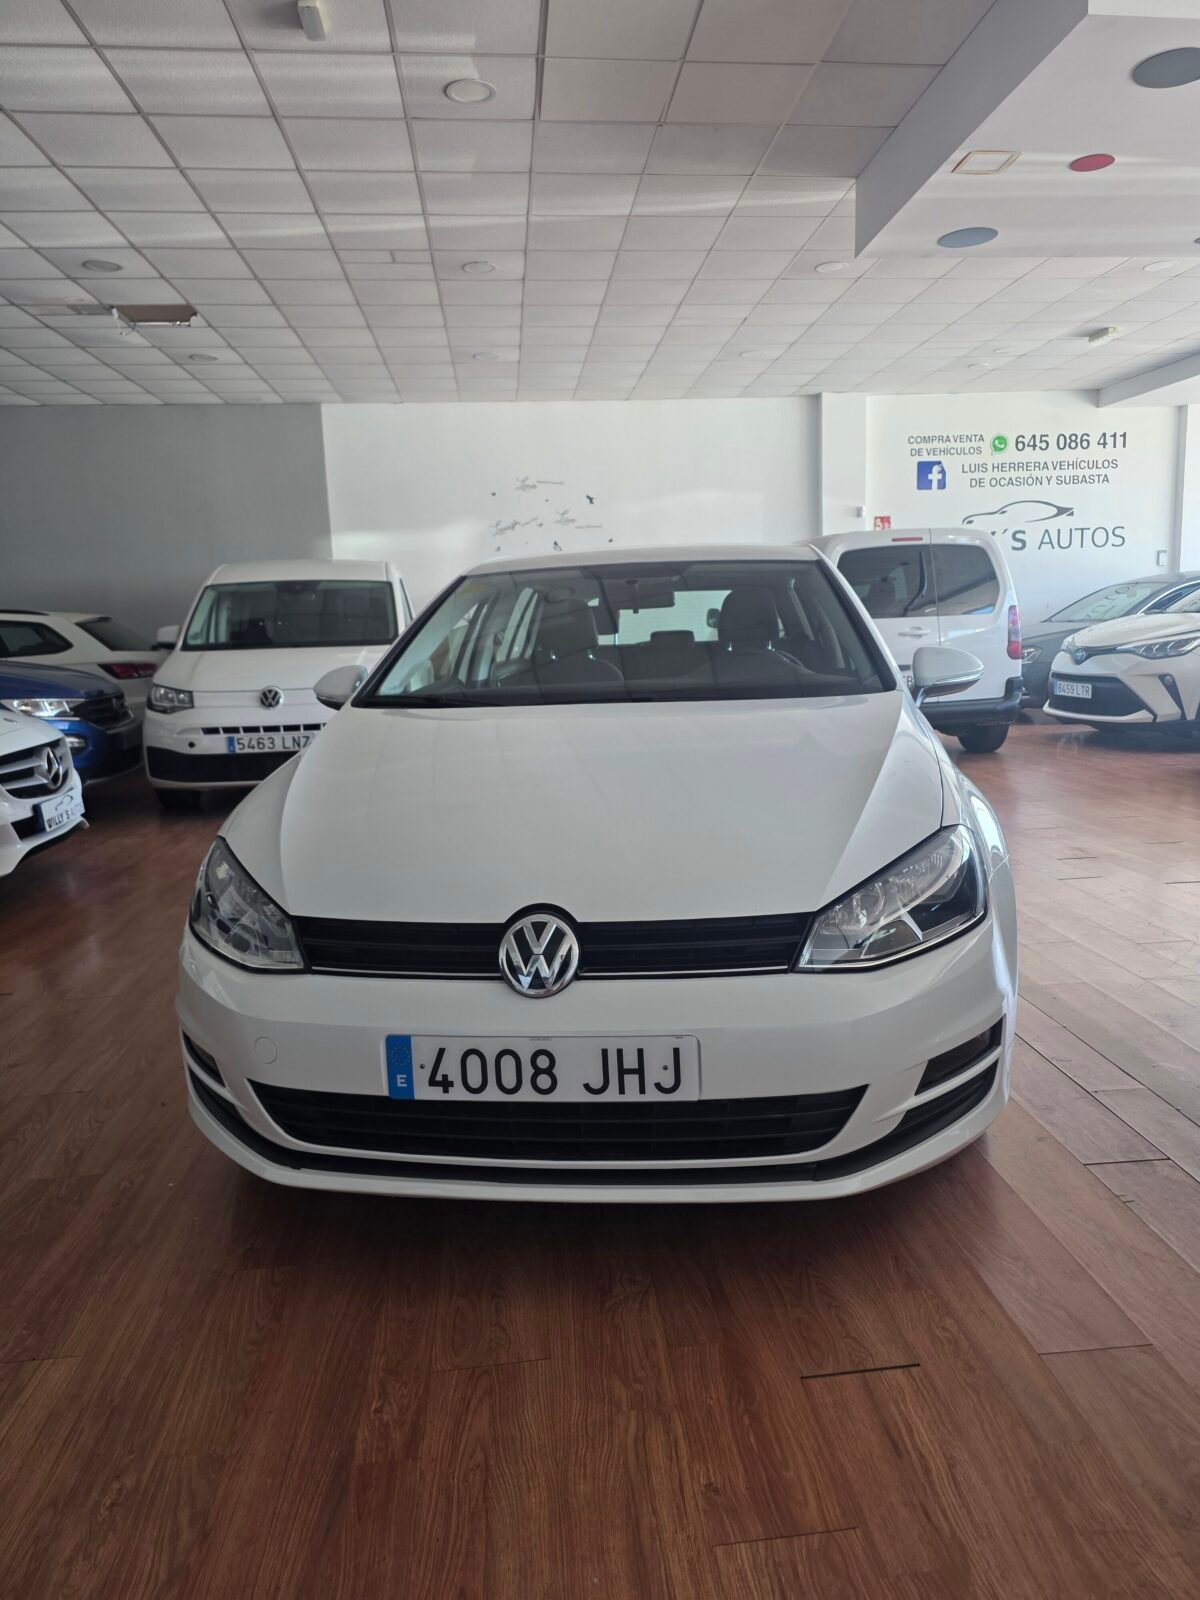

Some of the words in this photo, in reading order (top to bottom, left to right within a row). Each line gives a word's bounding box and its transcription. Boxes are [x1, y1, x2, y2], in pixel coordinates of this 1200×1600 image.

[907, 435, 951, 445] COMPRA
[952, 434, 985, 443] VENTA
[1015, 434, 1050, 452] 645
[1056, 433, 1091, 450] 086
[1097, 432, 1127, 449] 411
[910, 448, 924, 457] DE
[926, 445, 983, 457] VEHÍCULOS
[961, 462, 989, 474] LUIS
[992, 461, 1050, 473] HERRERA
[1051, 457, 1119, 471] VEHÍCULOS
[969, 477, 986, 488] DE
[989, 473, 1043, 488] OCASIÓN
[1045, 475, 1053, 486] Y
[1055, 473, 1110, 486] SUBASTA
[1038, 526, 1126, 551] AUTOS
[236, 736, 276, 751] 5463
[427, 1047, 558, 1095] 4008
[582, 1047, 682, 1095] JHJ
[396, 1074, 407, 1087] E
